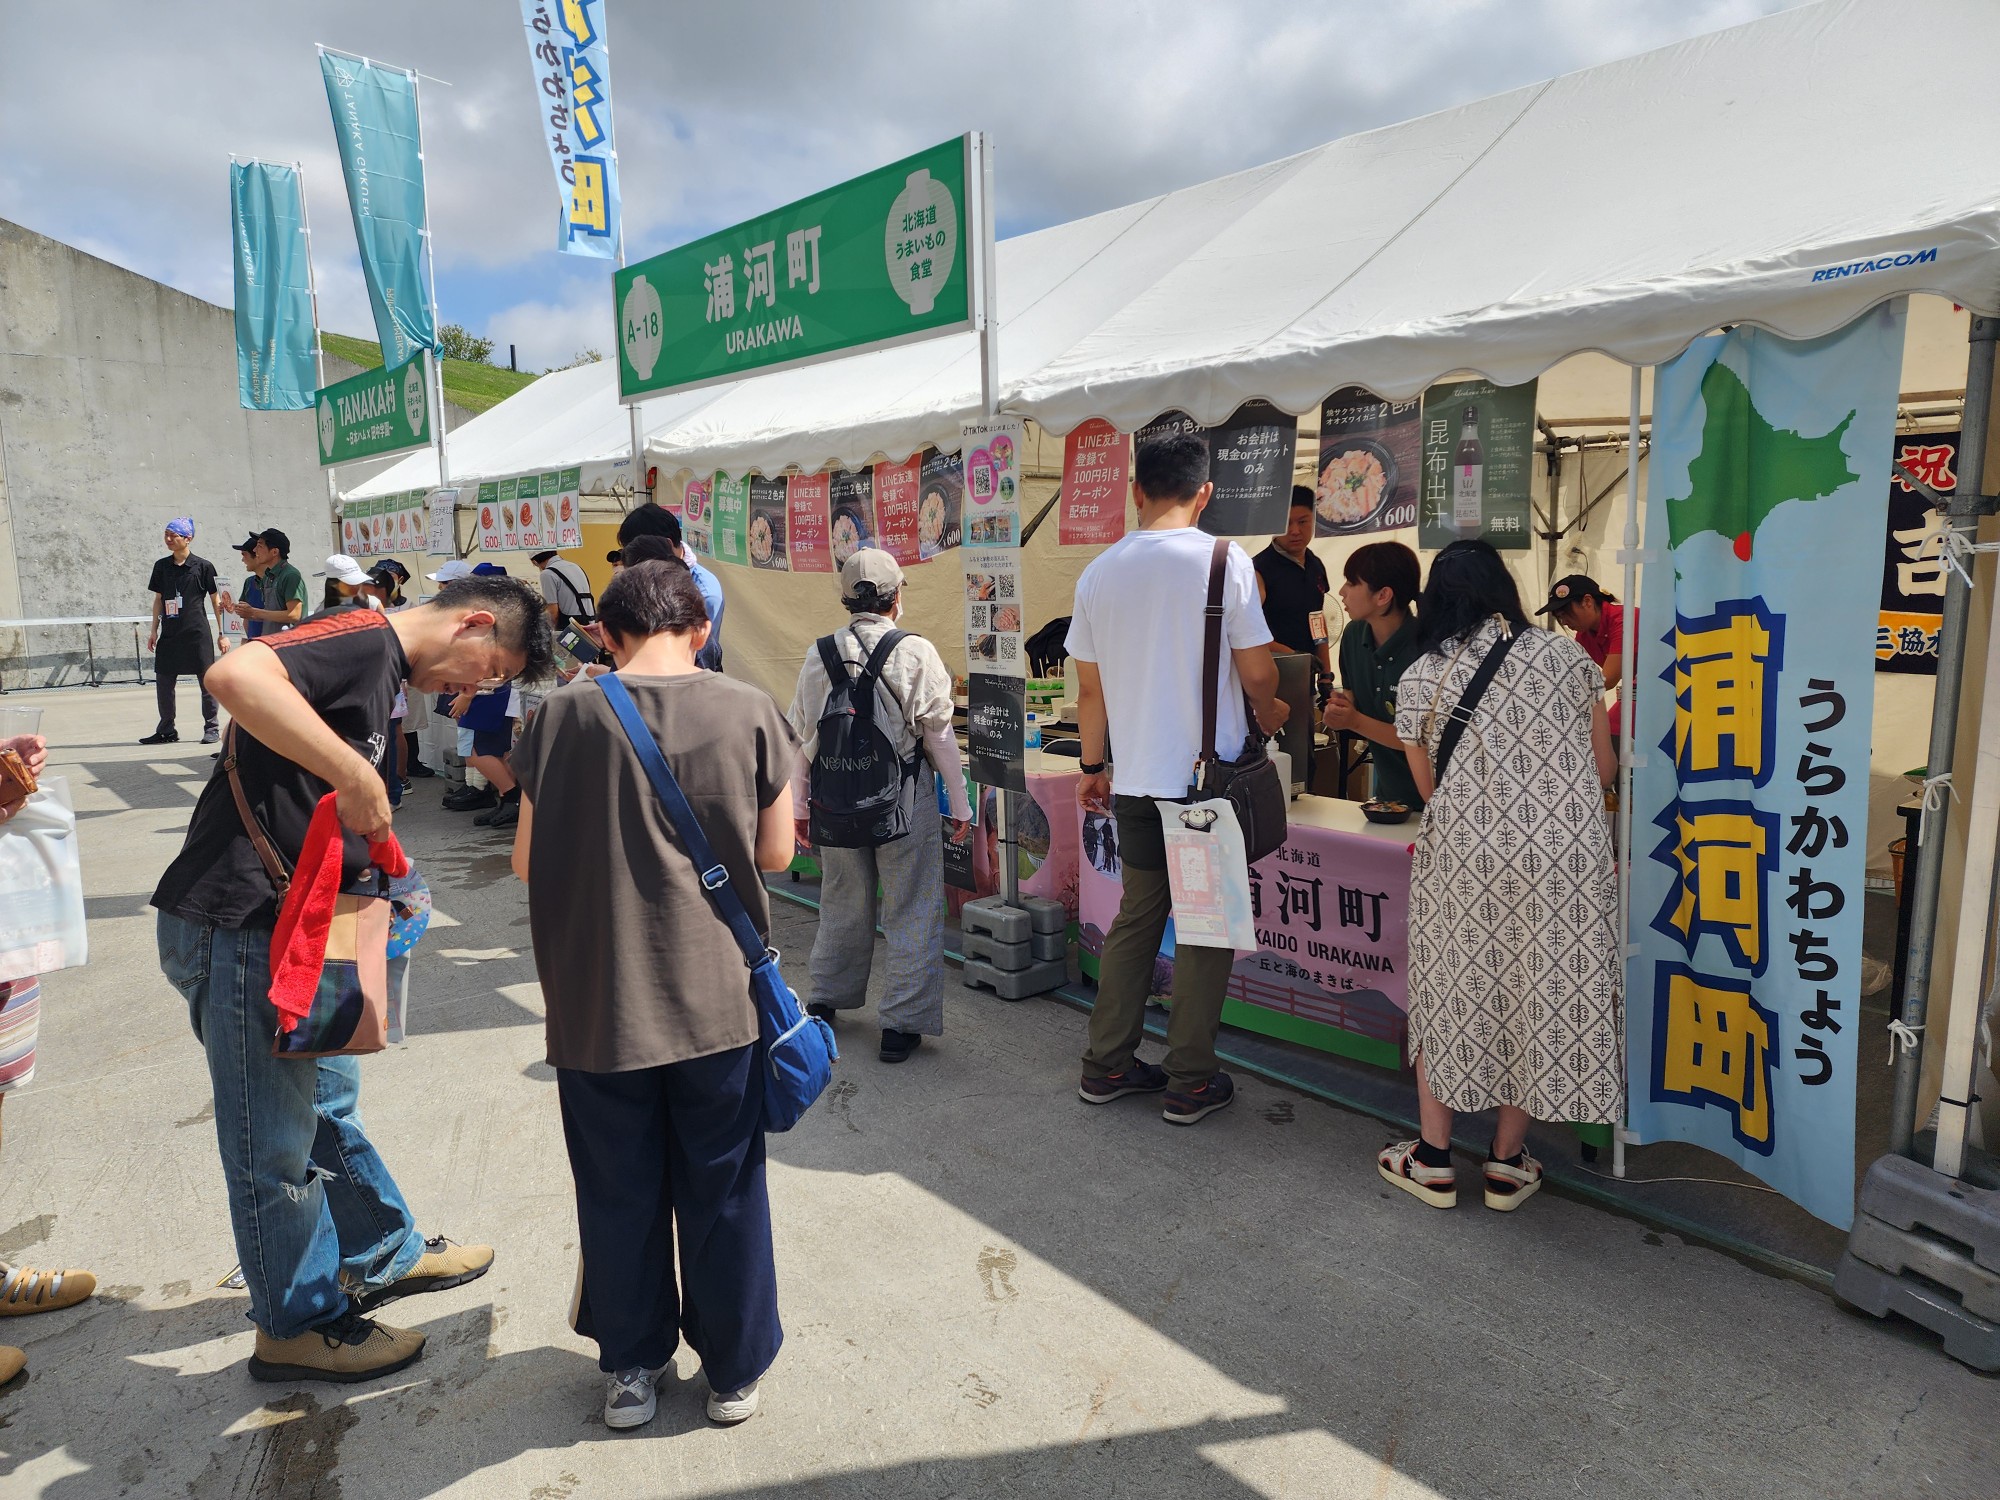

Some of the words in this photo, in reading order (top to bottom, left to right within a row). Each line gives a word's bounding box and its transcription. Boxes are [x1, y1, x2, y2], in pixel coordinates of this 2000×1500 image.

[902, 204, 937, 234] 北海道
[895, 229, 946, 260] うまいもの
[909, 258, 933, 283] 食堂
[1811, 247, 1938, 283] RENTACOM
[703, 224, 822, 324] 浦河町
[627, 312, 659, 345] A-18
[726, 315, 804, 356] URAKAWA
[337, 379, 396, 427] TANAKA村
[321, 418, 333, 435] A-17
[1326, 413, 1376, 426] オオズワイガニ
[969, 425, 988, 436] TikTok
[1237, 432, 1279, 445] お会計は
[1077, 432, 1120, 449] LINE友達
[1075, 451, 1107, 467] 登録で
[1216, 443, 1289, 461] 現金orチケット
[1073, 467, 1120, 484] 100円引き
[1244, 463, 1265, 475] のみ
[1426, 419, 1450, 529] 昆布出汁
[881, 470, 913, 488] LINE友達
[767, 489, 785, 501] 2色丼
[793, 487, 821, 498] LINE友達
[850, 481, 871, 495] 2色丼
[882, 488, 905, 503] 登録で
[1072, 486, 1112, 501] クーポン
[883, 500, 918, 517] 100円引き
[1069, 503, 1099, 519] 配布中
[1374, 503, 1416, 528] ¥600
[794, 514, 823, 526] 100円引き
[886, 517, 914, 532] クーポン
[1490, 516, 1521, 532] 無料
[795, 529, 819, 539] クーポン
[886, 532, 909, 547] 配布中
[983, 705, 1010, 718] お会計は
[973, 715, 1019, 731] 現金orチケット
[989, 730, 1003, 740] のみ
[1276, 846, 1321, 867] 北海道
[1650, 594, 1787, 1157] 浦河町
[1785, 679, 1849, 1087] うらかわちょう
[1254, 927, 1298, 953] KAIDO
[1307, 940, 1395, 974] URAKAWA
